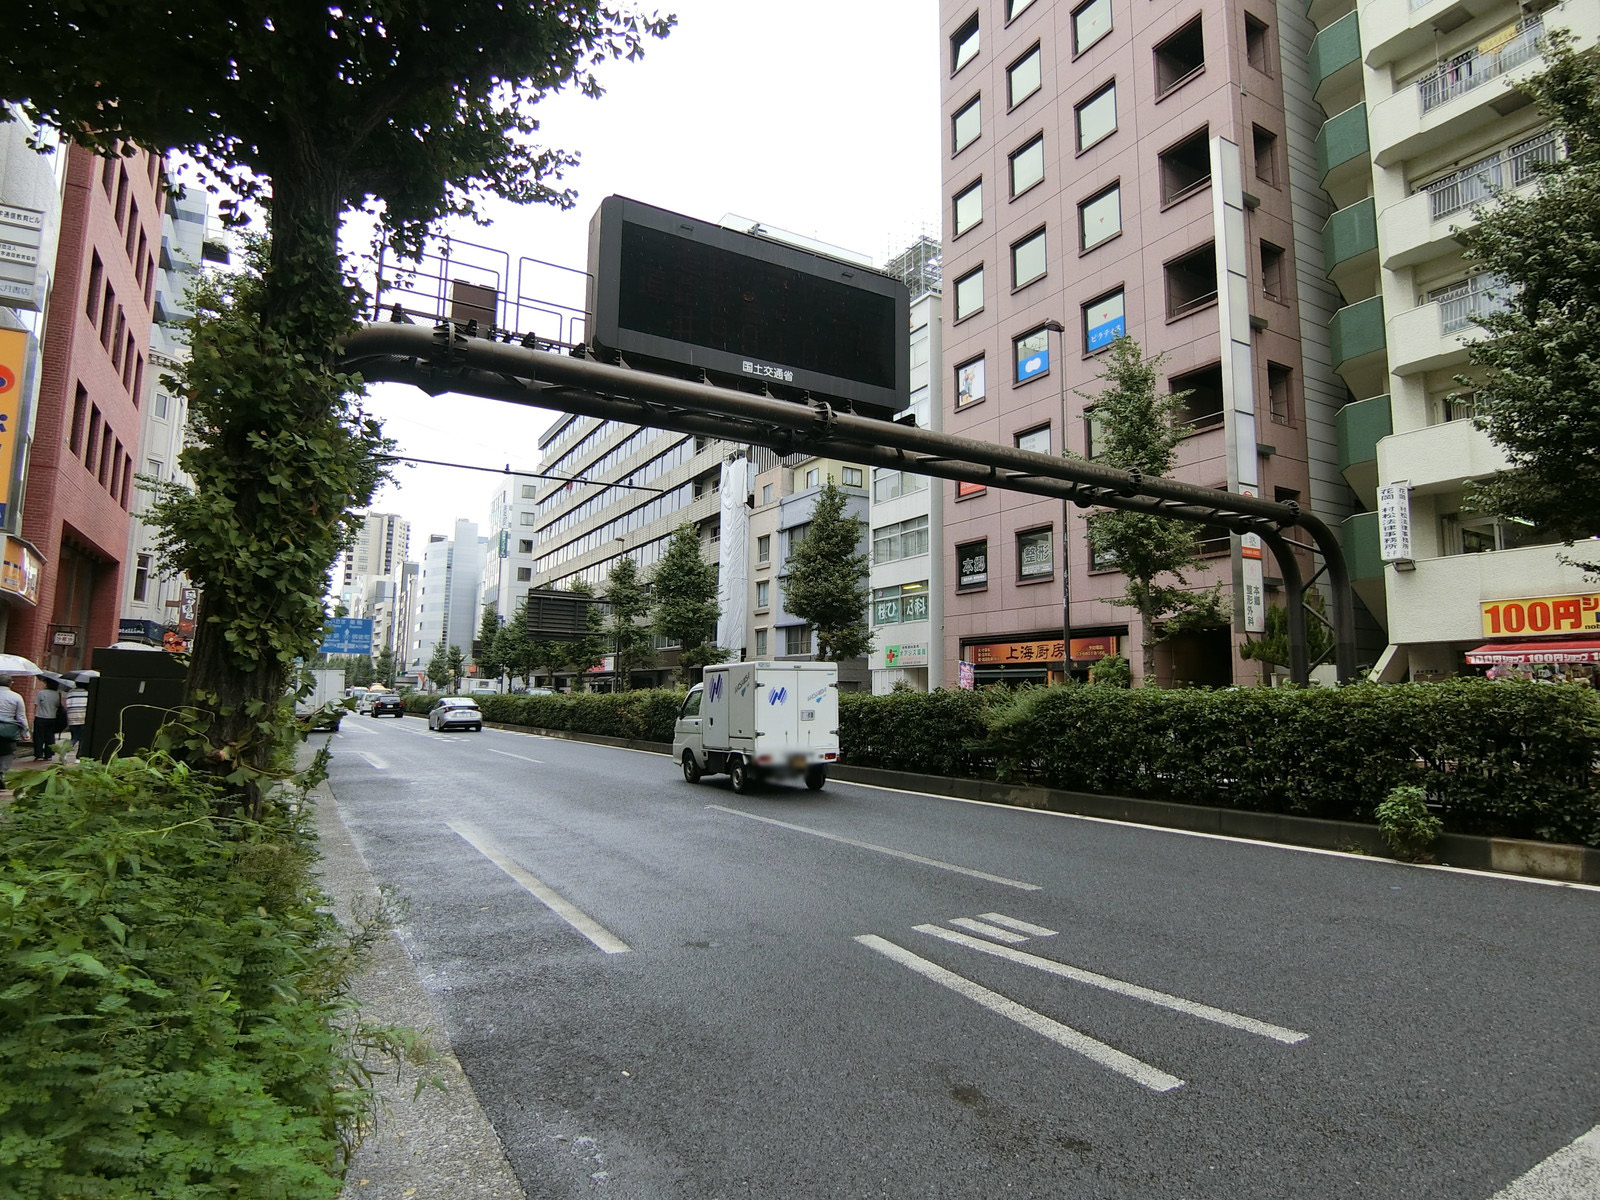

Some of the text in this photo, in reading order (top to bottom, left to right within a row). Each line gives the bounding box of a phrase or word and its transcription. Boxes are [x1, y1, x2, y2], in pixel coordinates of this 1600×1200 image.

[0, 243, 17, 252] 団法人
[742, 360, 794, 382] 国土交通省
[1023, 543, 1051, 564] 整形
[962, 555, 986, 574] 本郷
[1253, 585, 1260, 605] 本郷
[1246, 584, 1254, 626] 整形外科
[1005, 643, 1066, 661] 上海厨房
[1527, 653, 1588, 663] 100円ショップ
